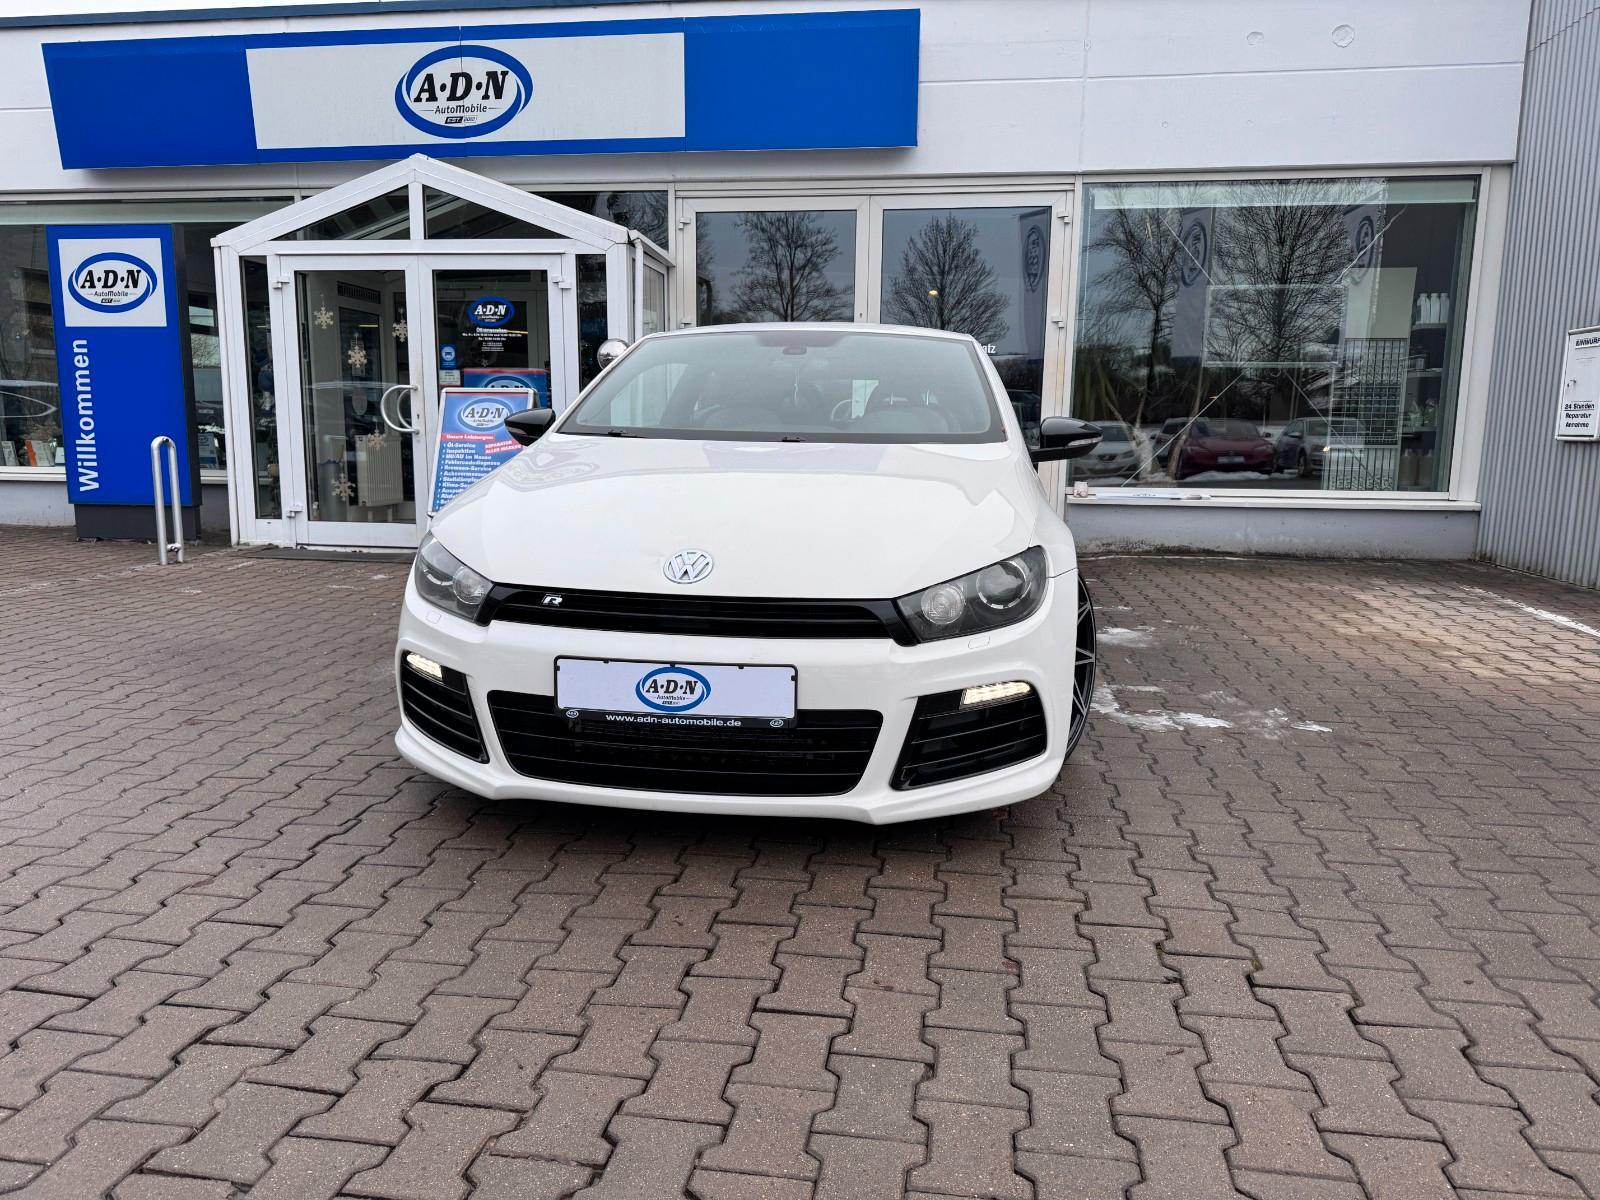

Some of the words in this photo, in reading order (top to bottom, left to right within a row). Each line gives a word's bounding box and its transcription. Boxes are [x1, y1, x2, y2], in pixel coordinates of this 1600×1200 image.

[1573, 401, 1595, 409] Stunden
[73, 339, 99, 492] Willkommen
[1565, 412, 1591, 420] Reparatur
[540, 593, 563, 606] R
[605, 713, 742, 727] www.adn-automobile.de
